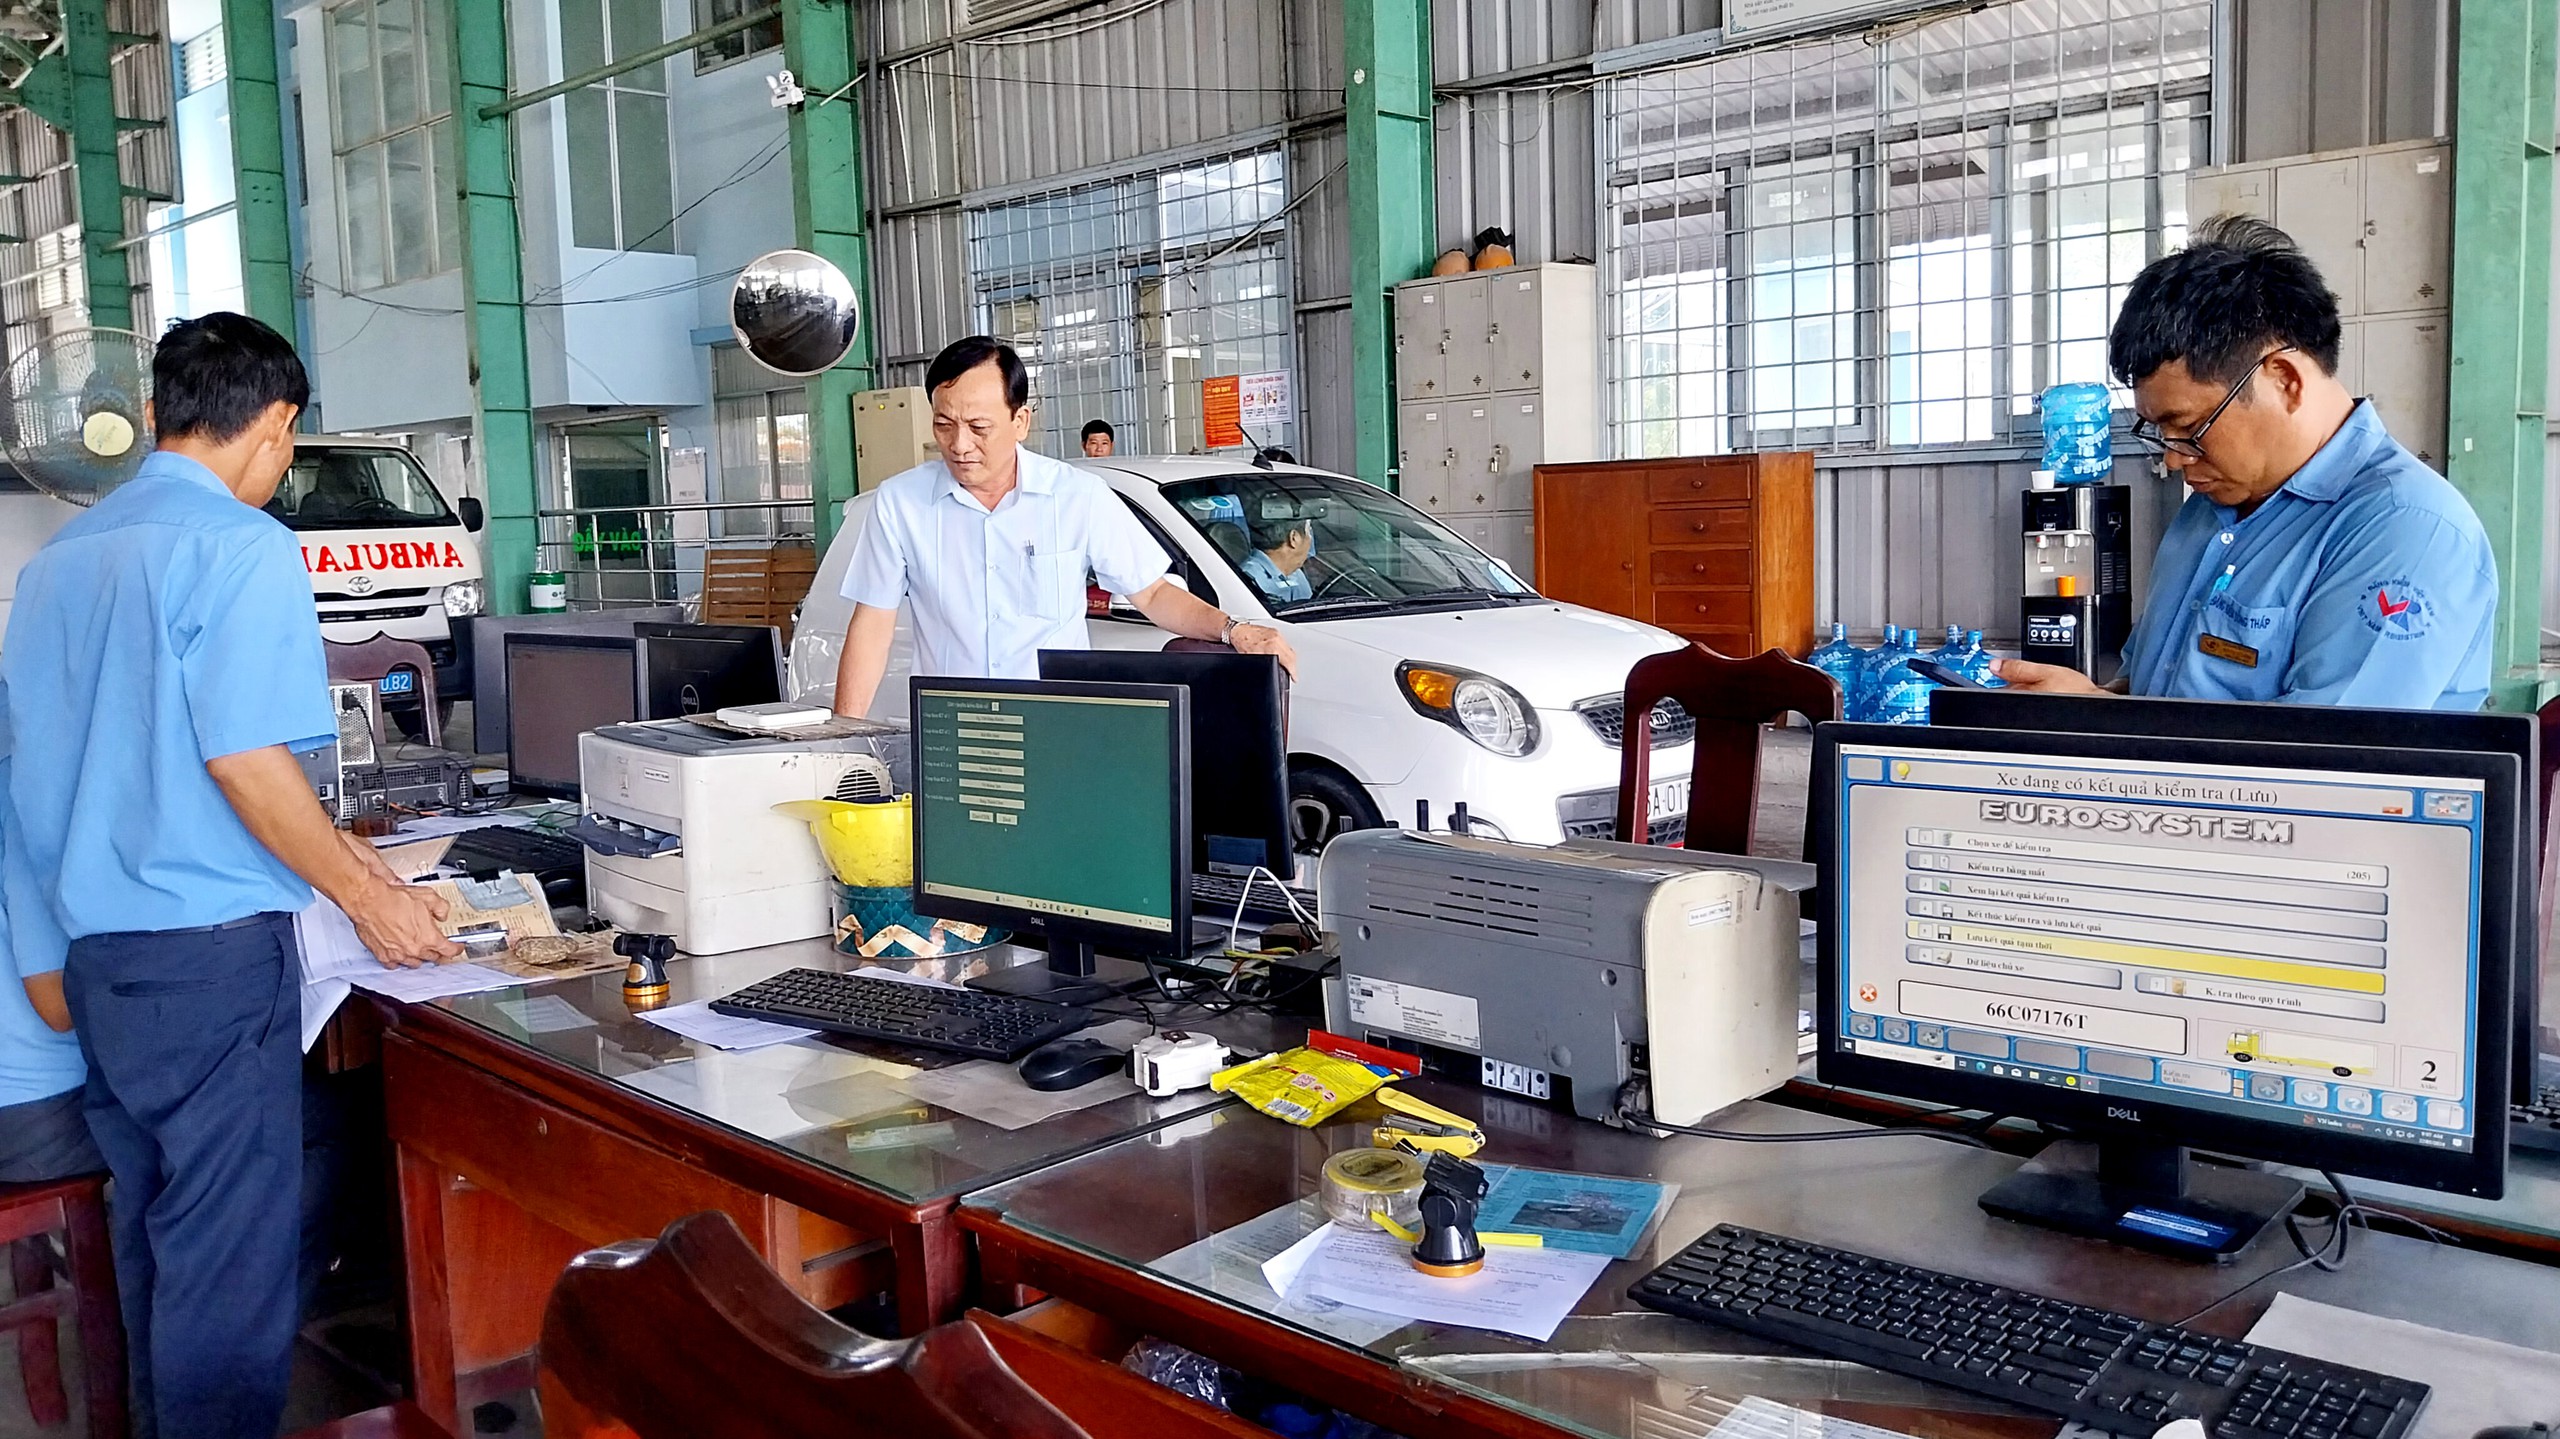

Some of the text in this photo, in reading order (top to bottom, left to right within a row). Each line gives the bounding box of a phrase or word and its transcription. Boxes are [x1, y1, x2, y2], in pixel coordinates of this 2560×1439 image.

[610, 527, 641, 551] VÀO
[2250, 614, 2271, 629] THÁP
[1997, 772, 2279, 806] Xe đang có kết quả kiểm tra (Lưu)
[1980, 799, 2294, 845] EUROSYSTEM
[1992, 864, 2005, 873] tra
[2038, 844, 2052, 853] tra
[2346, 870, 2372, 881] (205)
[1967, 885, 1987, 895] Xem
[2057, 894, 2070, 904] tra
[2218, 990, 2233, 999] tra
[2235, 991, 2256, 1002] theo
[2258, 995, 2275, 1006] quy
[1986, 1001, 2089, 1029] 66C07176T
[2421, 1060, 2438, 1083] 2
[2107, 1106, 2142, 1122] DELL
